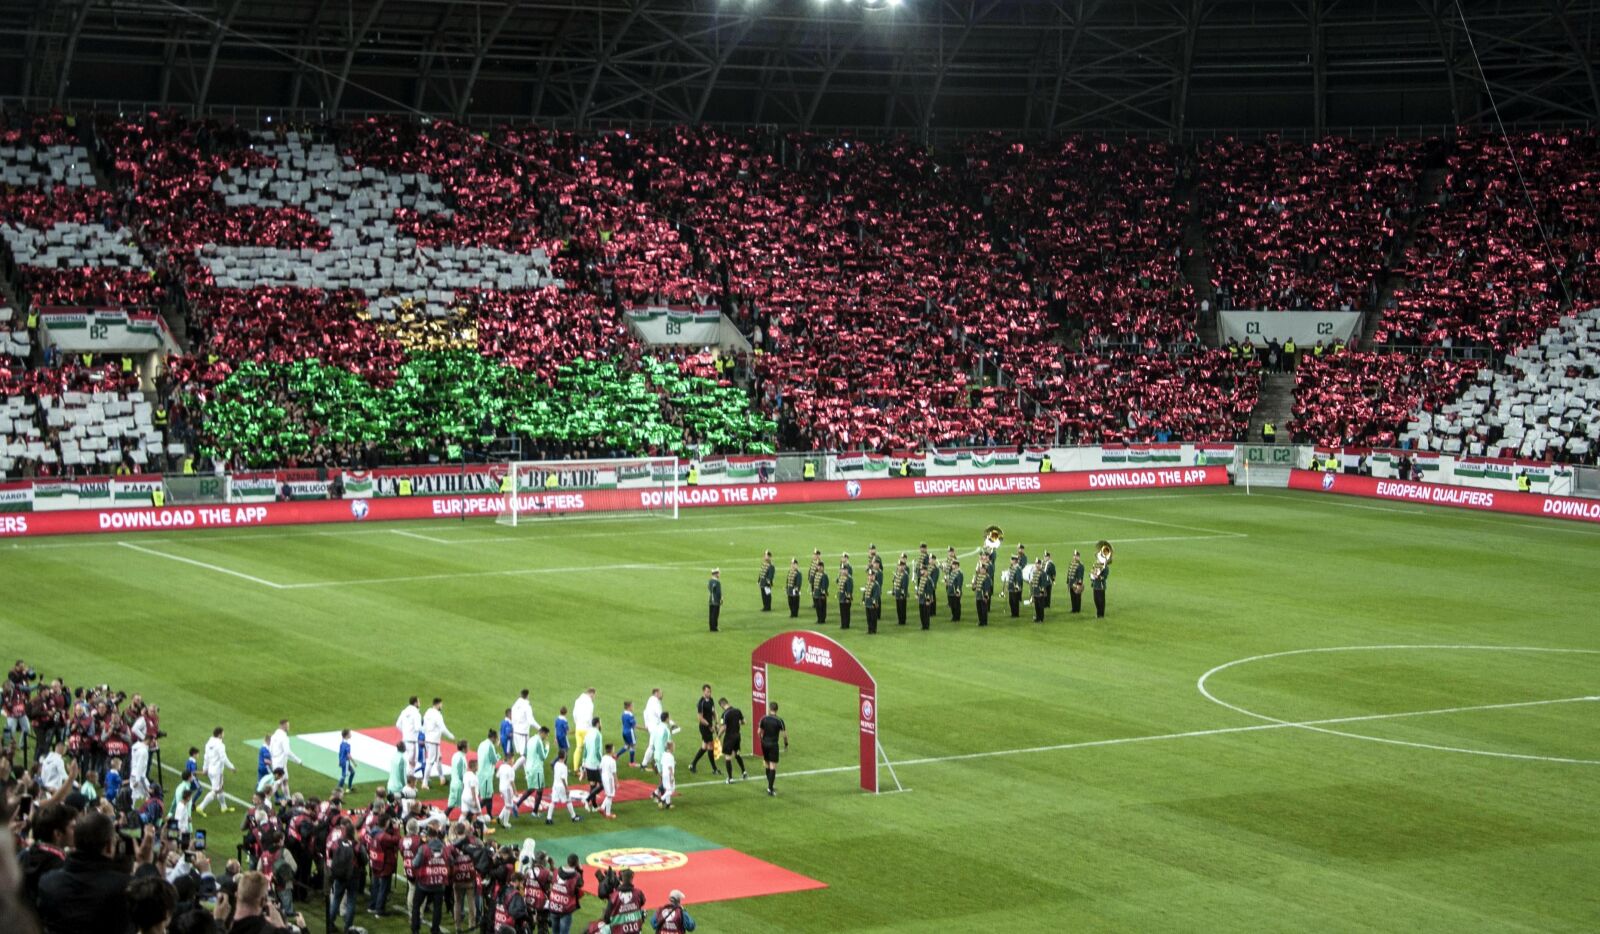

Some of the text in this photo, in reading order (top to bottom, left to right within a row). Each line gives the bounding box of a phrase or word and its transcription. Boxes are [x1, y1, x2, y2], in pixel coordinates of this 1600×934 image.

[90, 325, 108, 339] B2
[666, 322, 681, 335] B3
[1246, 322, 1261, 334] C1
[1317, 322, 1333, 335] C2
[1248, 448, 1263, 461] C1
[1273, 449, 1290, 462] C2
[377, 473, 487, 496] CAPATHIAN
[913, 476, 1041, 493] EUROPEAN QUALIFIERS
[1089, 469, 1206, 487] DOWNLOAD THE APP
[201, 480, 219, 494] B2
[1376, 481, 1494, 506] EUROPEAN QUALIFIERS
[641, 486, 777, 505] DOWNLOAD THE APP
[432, 494, 584, 514] EUROPEAN QUALIFIERS
[99, 506, 267, 528] DOWNLOAD THE APP
[808, 645, 830, 657] EUROPEAN
[805, 652, 833, 668] QUALIFIERS
[623, 923, 639, 932] 010
